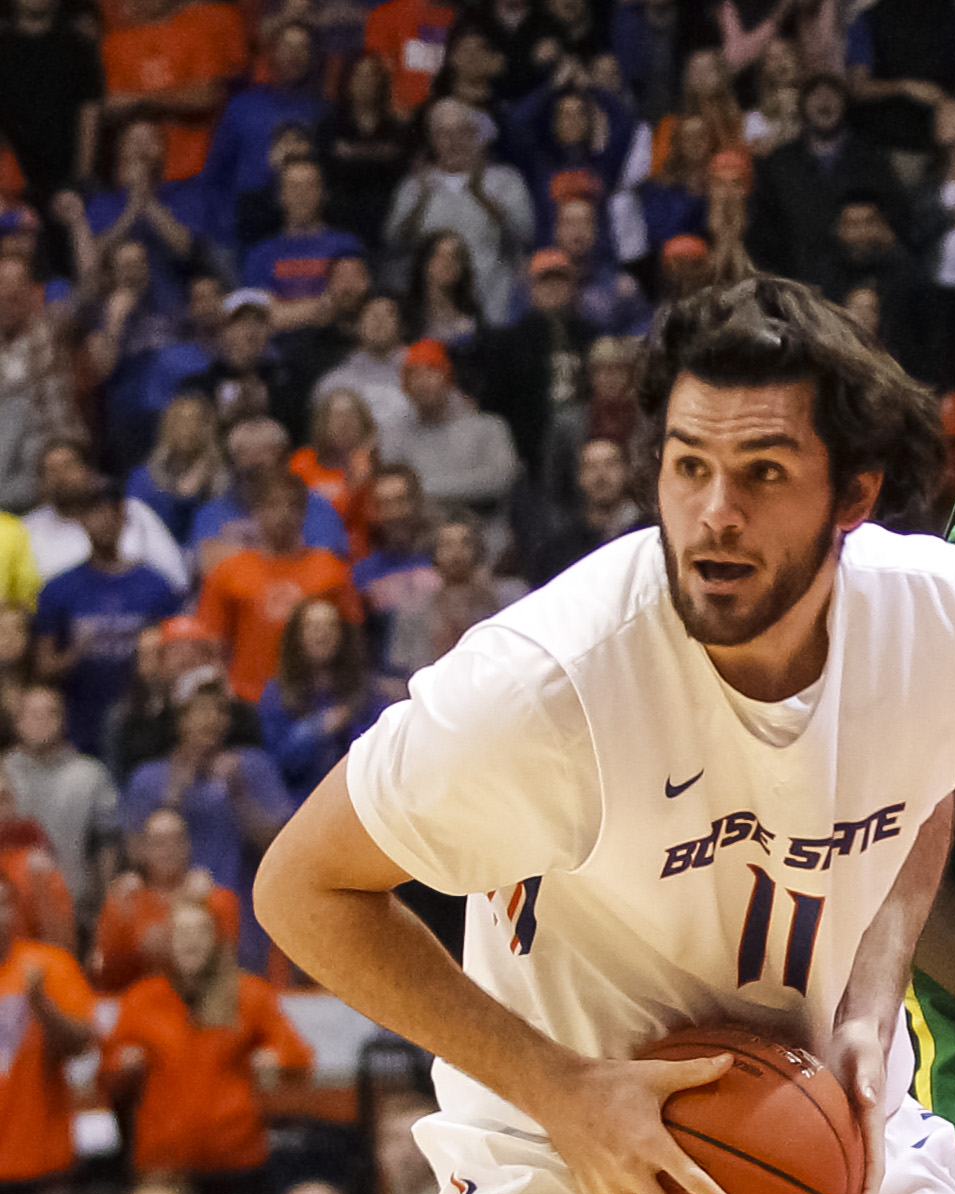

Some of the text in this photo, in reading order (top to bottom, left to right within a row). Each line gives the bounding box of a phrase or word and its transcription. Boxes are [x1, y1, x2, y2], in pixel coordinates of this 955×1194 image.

[659, 810, 776, 879] BOISE
[783, 801, 906, 871] STATE
[737, 863, 826, 998] 11
